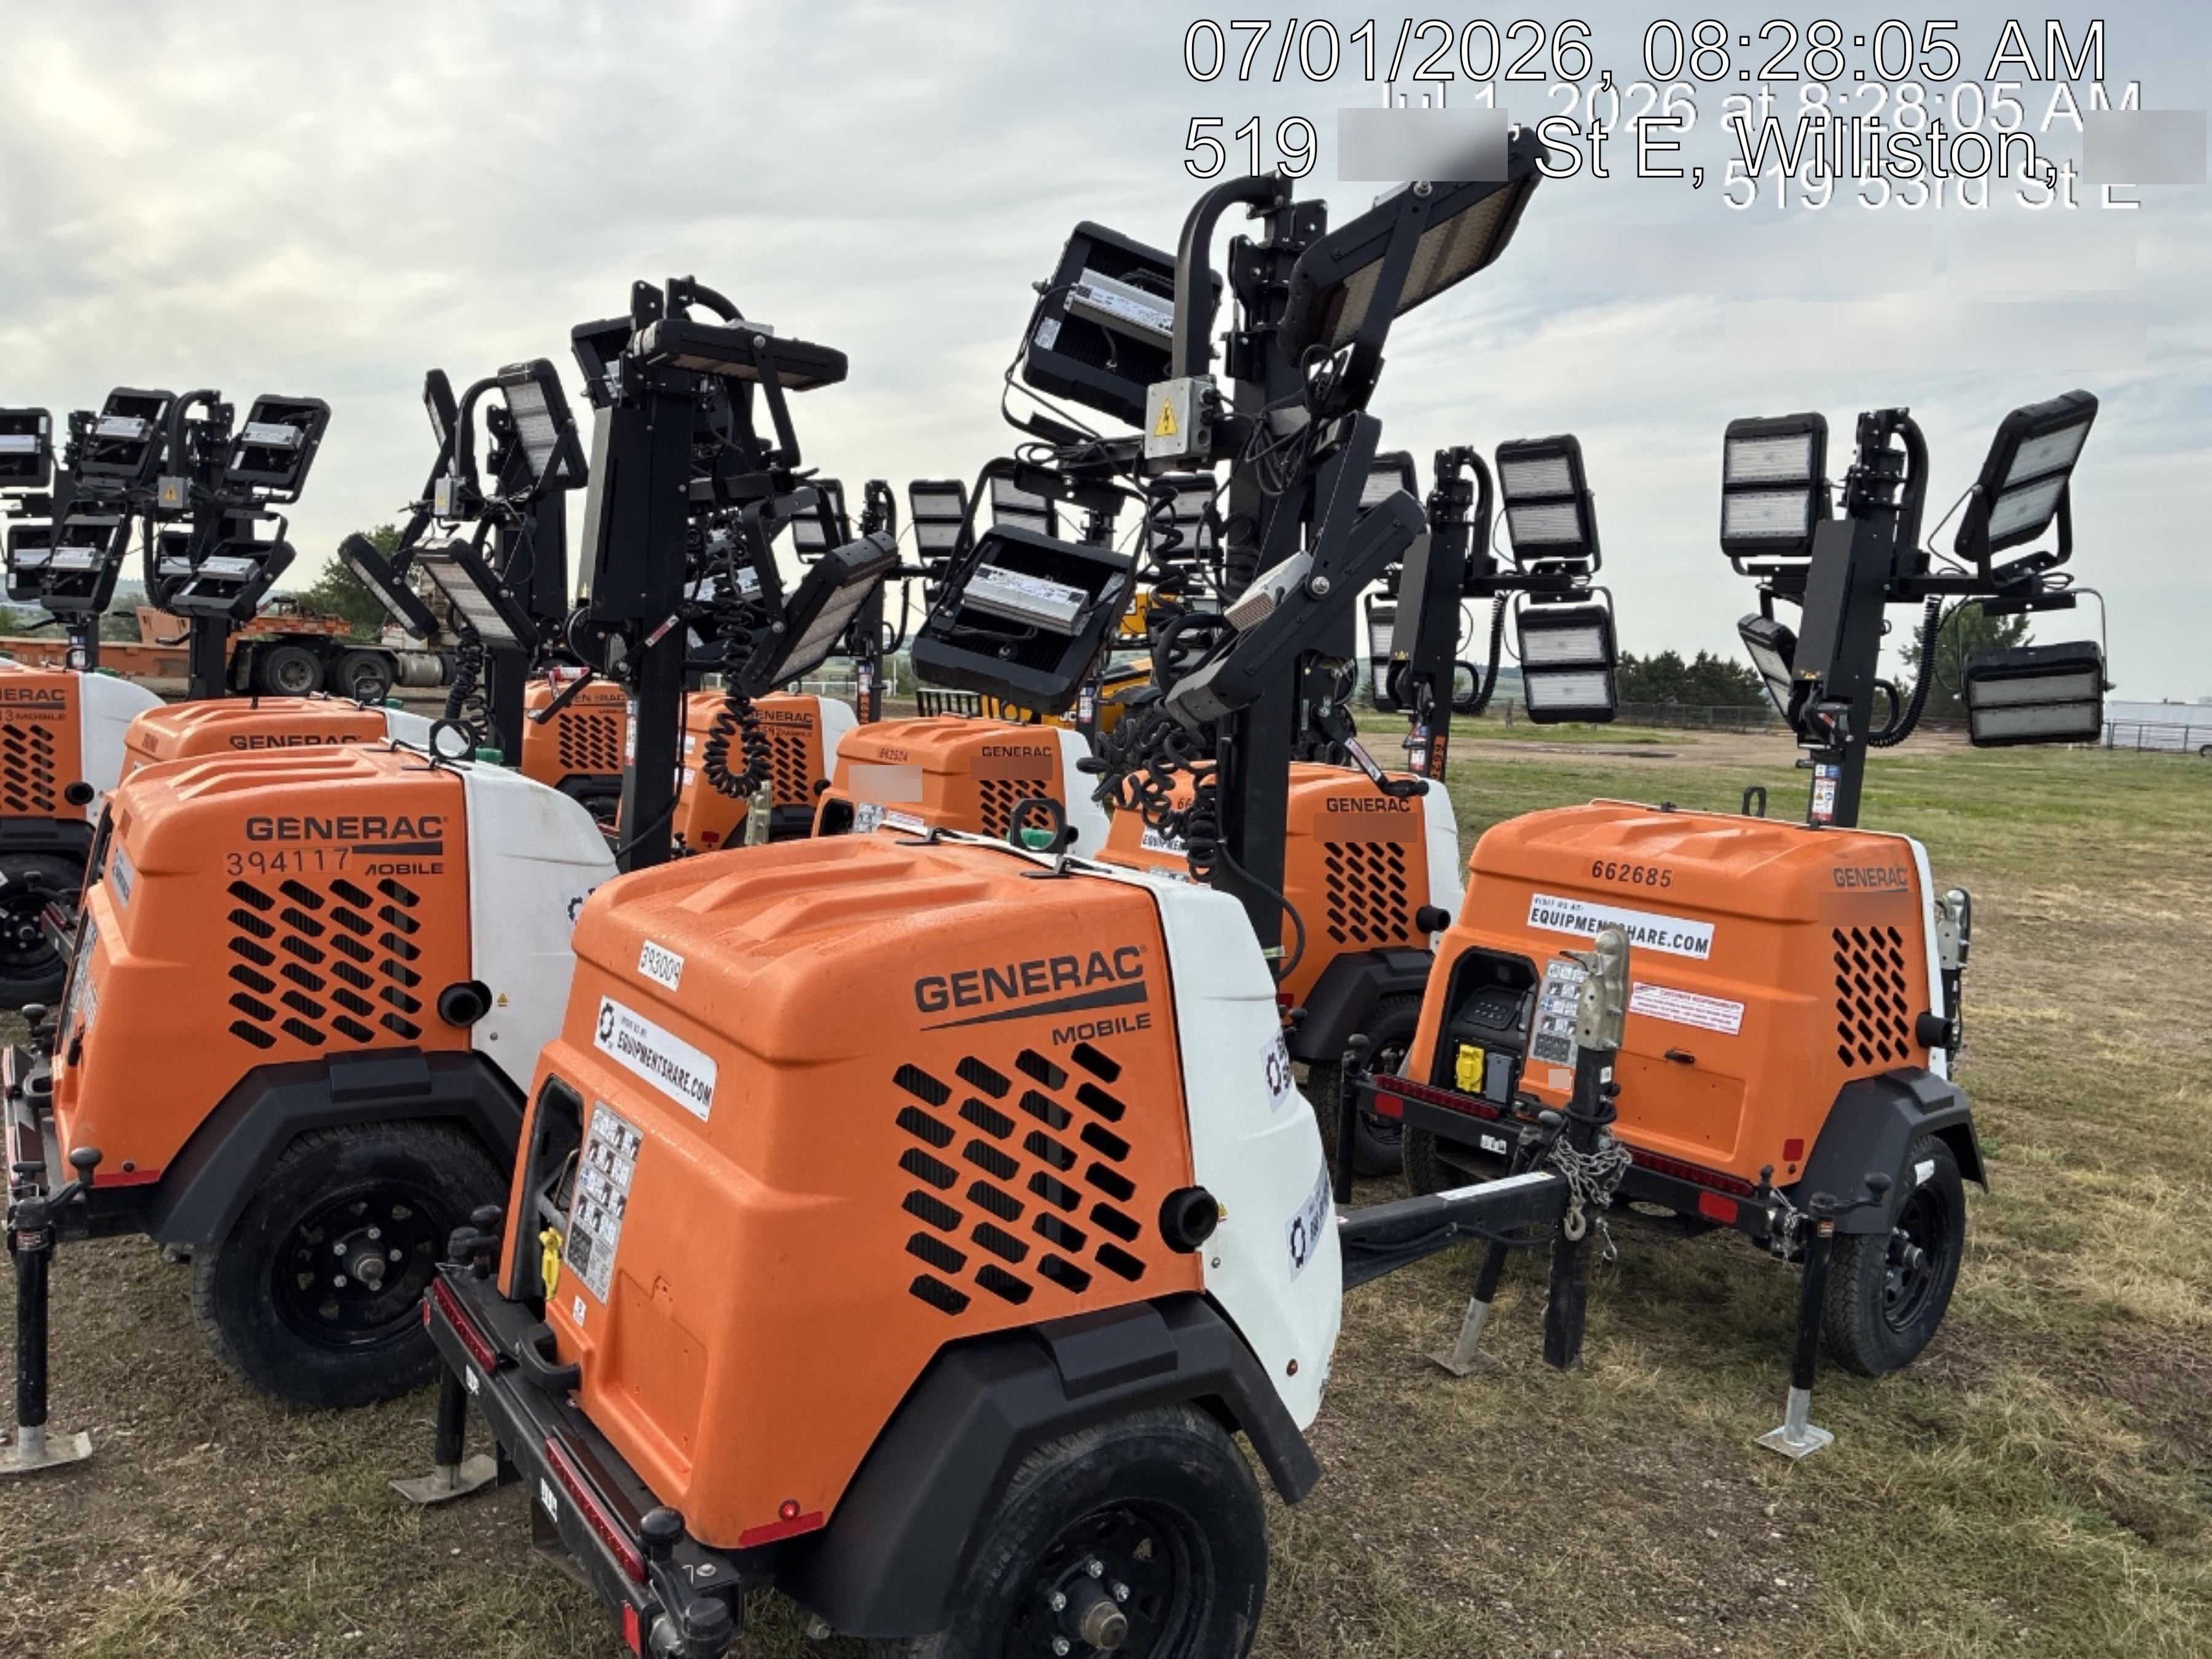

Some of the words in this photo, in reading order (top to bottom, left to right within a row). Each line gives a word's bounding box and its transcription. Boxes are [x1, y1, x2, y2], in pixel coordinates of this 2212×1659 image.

[0, 688, 65, 701] ERAC
[753, 709, 812, 723] ENERAC
[981, 746, 1052, 757] GENERAC
[1327, 798, 1411, 812] GENERAC
[246, 816, 443, 841] GENERAC
[226, 848, 349, 876] 394117
[1592, 860, 1672, 888] 662685
[1833, 866, 1908, 887] GENERAC
[1531, 908, 1709, 954] EQUIPMENHARE.COM
[914, 946, 1143, 1013] GENERAC
[1051, 1013, 1151, 1046] MOBILE
[616, 1030, 712, 1106] EQUIPMENTSHARE.COM
